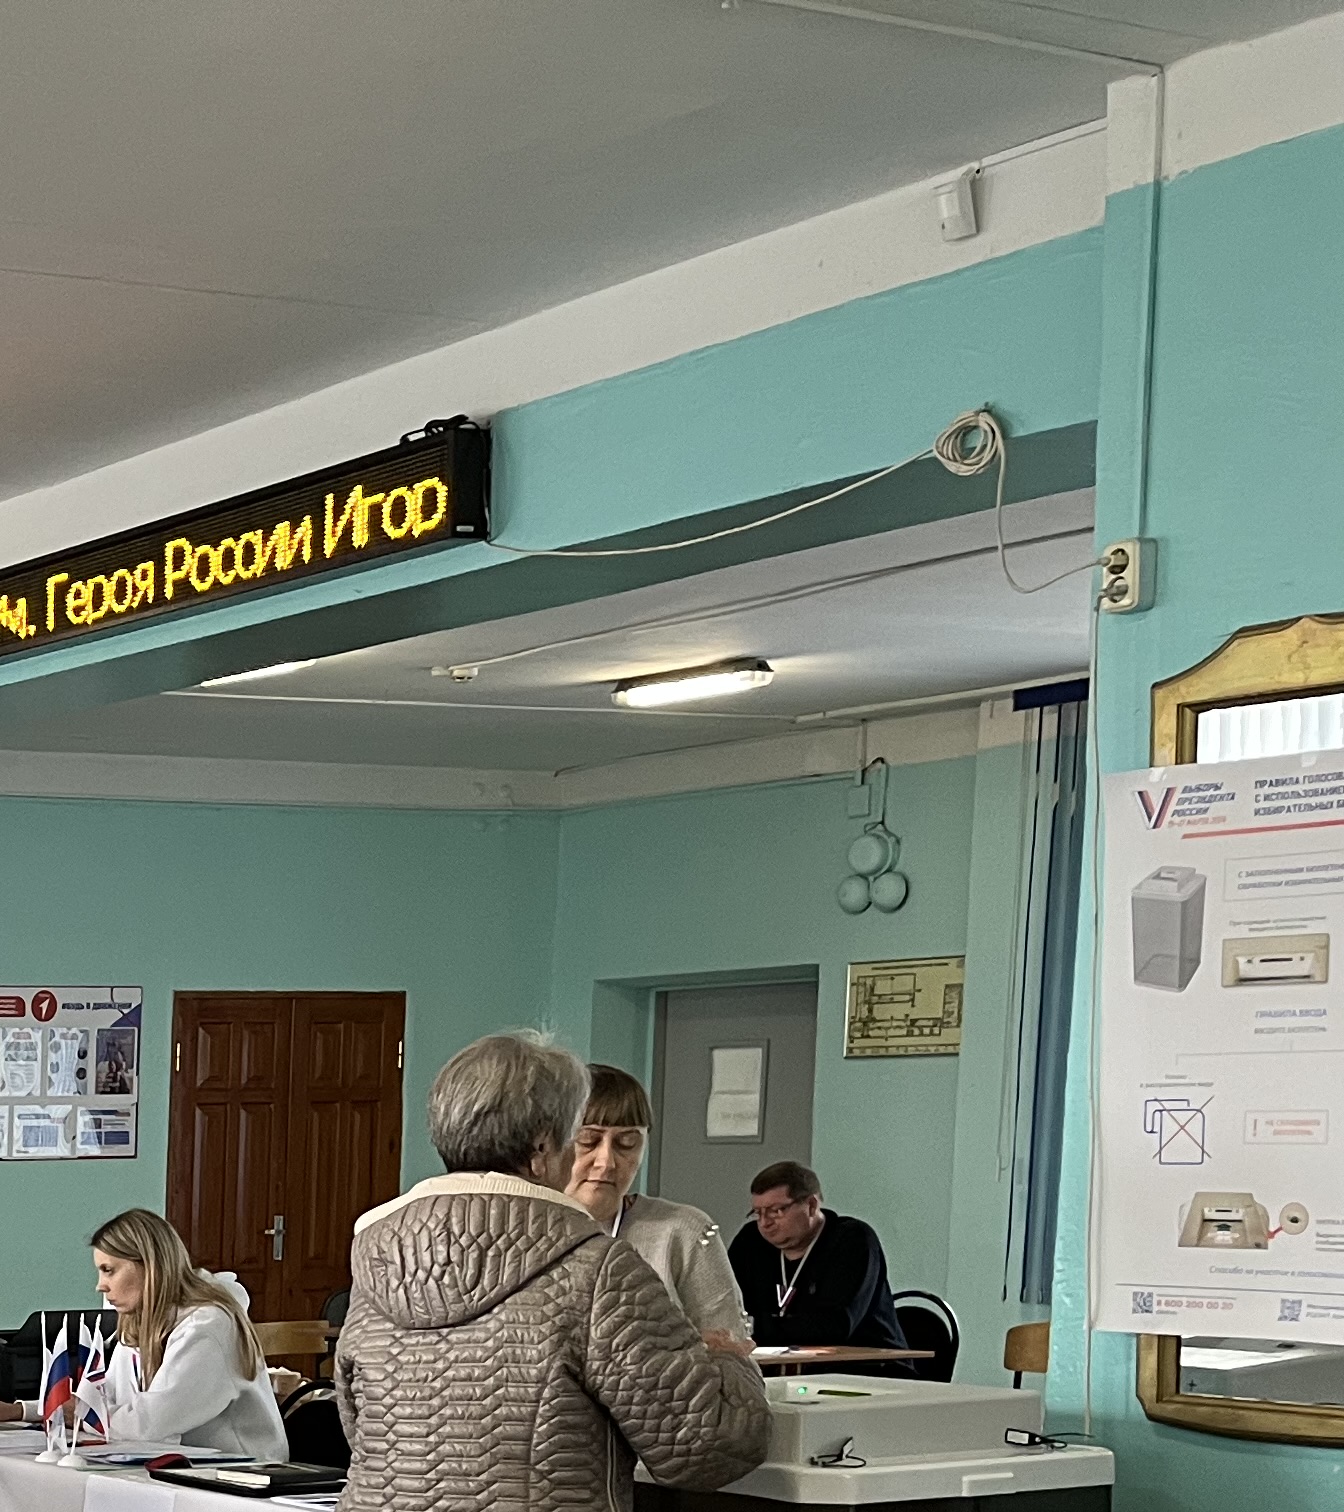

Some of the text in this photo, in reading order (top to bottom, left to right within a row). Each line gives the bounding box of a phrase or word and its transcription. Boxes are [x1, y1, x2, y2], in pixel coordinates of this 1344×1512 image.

[45, 561, 154, 631] Героя
[165, 516, 312, 599] России
[323, 477, 448, 558] Игор
[1254, 776, 1299, 789] ПРАВИЛА
